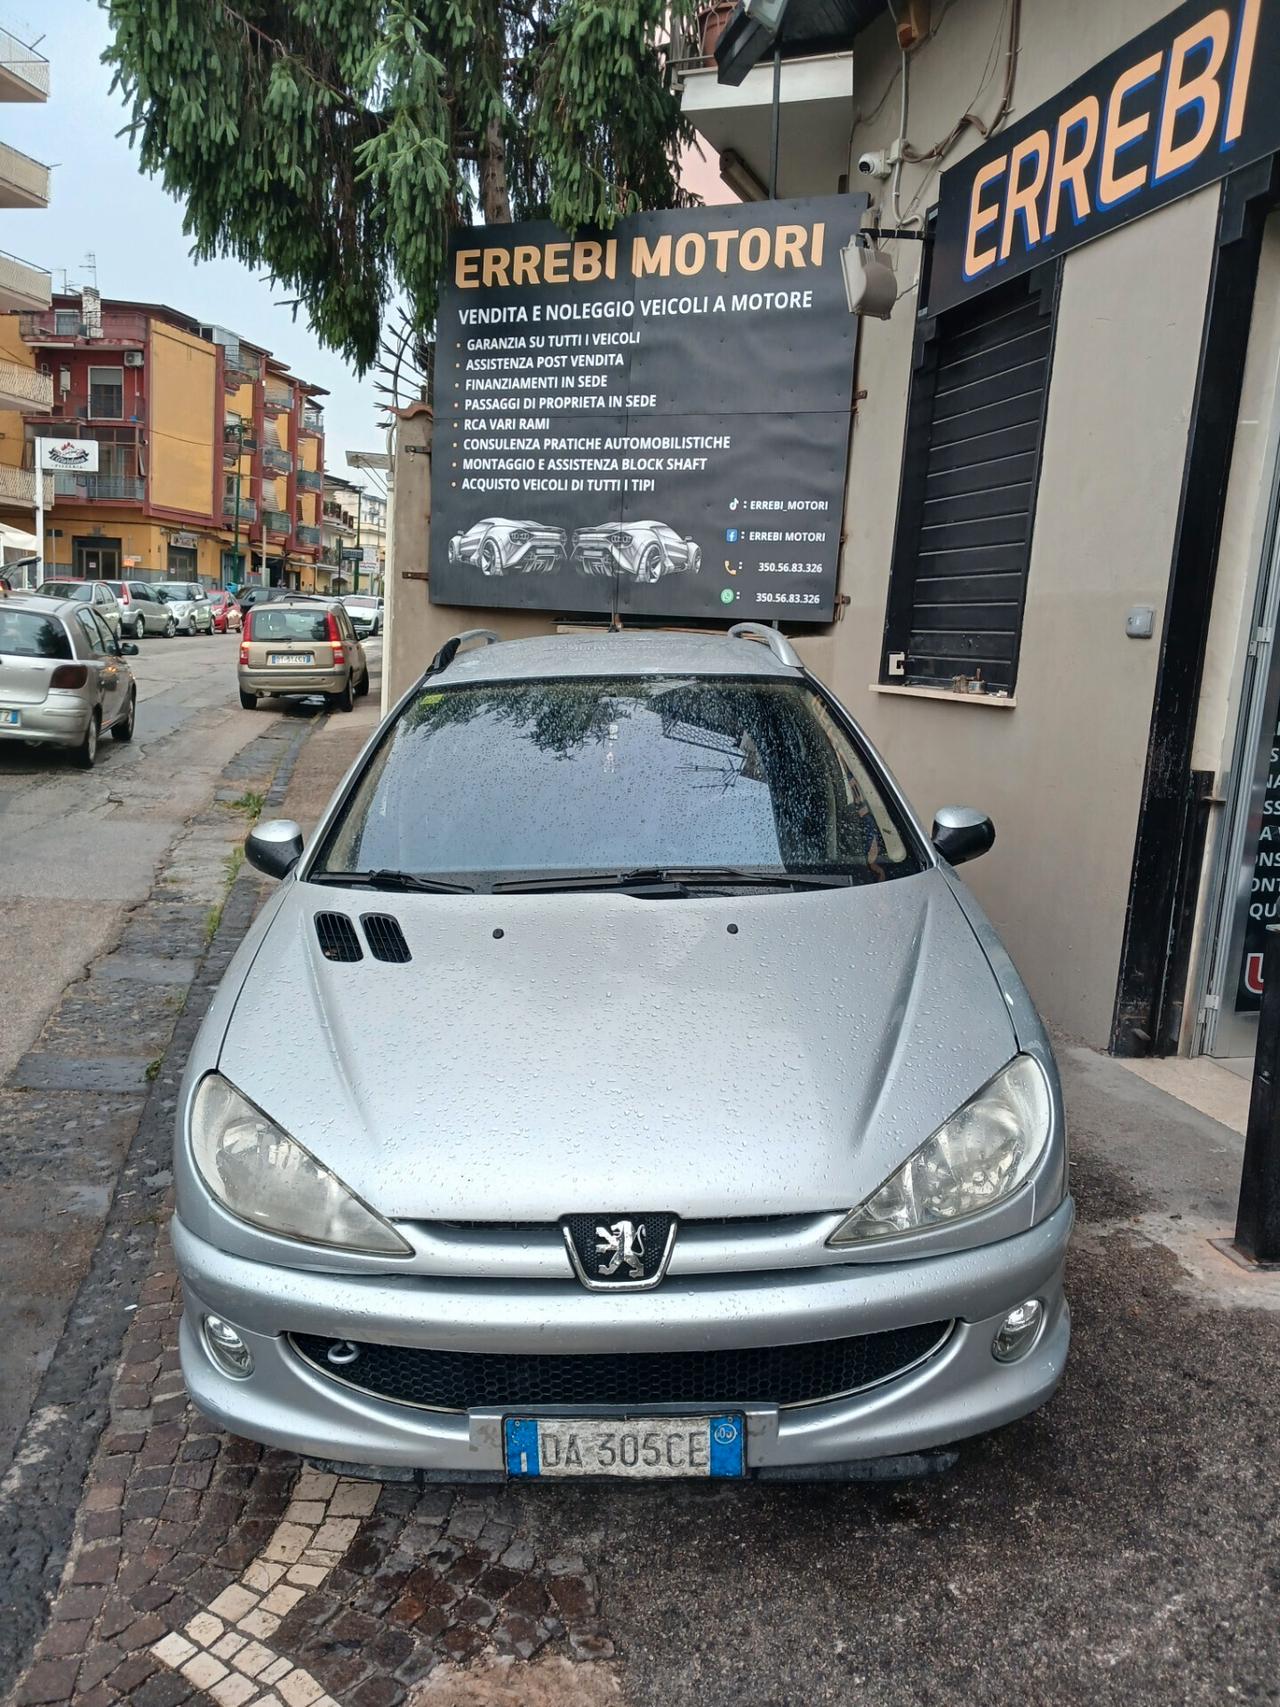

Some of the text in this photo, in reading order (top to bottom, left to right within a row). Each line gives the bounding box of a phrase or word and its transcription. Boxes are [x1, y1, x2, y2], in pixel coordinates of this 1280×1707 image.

[962, 0, 1262, 282] ERREBI
[455, 223, 825, 288] ERREBI MOTORI
[458, 291, 813, 324] VENDITA E NOLEGGIO VEICOLI A MOTORE
[467, 332, 641, 350] GARANZIA SU TUTTI I VEICOLI
[465, 354, 625, 370] ASSISTENZA POST VENDITA
[465, 375, 608, 390] FINANZIAMENTI IN SEDE
[464, 395, 657, 410] PASSAGGI DI PROPRIETA IN SEDE
[464, 418, 550, 430] RCA VARI RAMI
[463, 436, 731, 449] CONSULENZA PRATICHE AUTOMOBILISTICHE
[462, 458, 708, 470] MONTAGGIO E ASSISTENZA BLOCK SHAFT
[461, 478, 655, 492] ACQUISTO VEICOLI DI TUTTI I TIPI
[750, 501, 829, 511] ERREBI_MOTORI
[749, 532, 826, 541] ERREBI MOTORI
[758, 563, 823, 572] 350.56.83.326
[755, 593, 820, 603] 350.56.83.326
[541, 1432, 583, 1468] DA
[597, 1431, 709, 1468] 305CE
